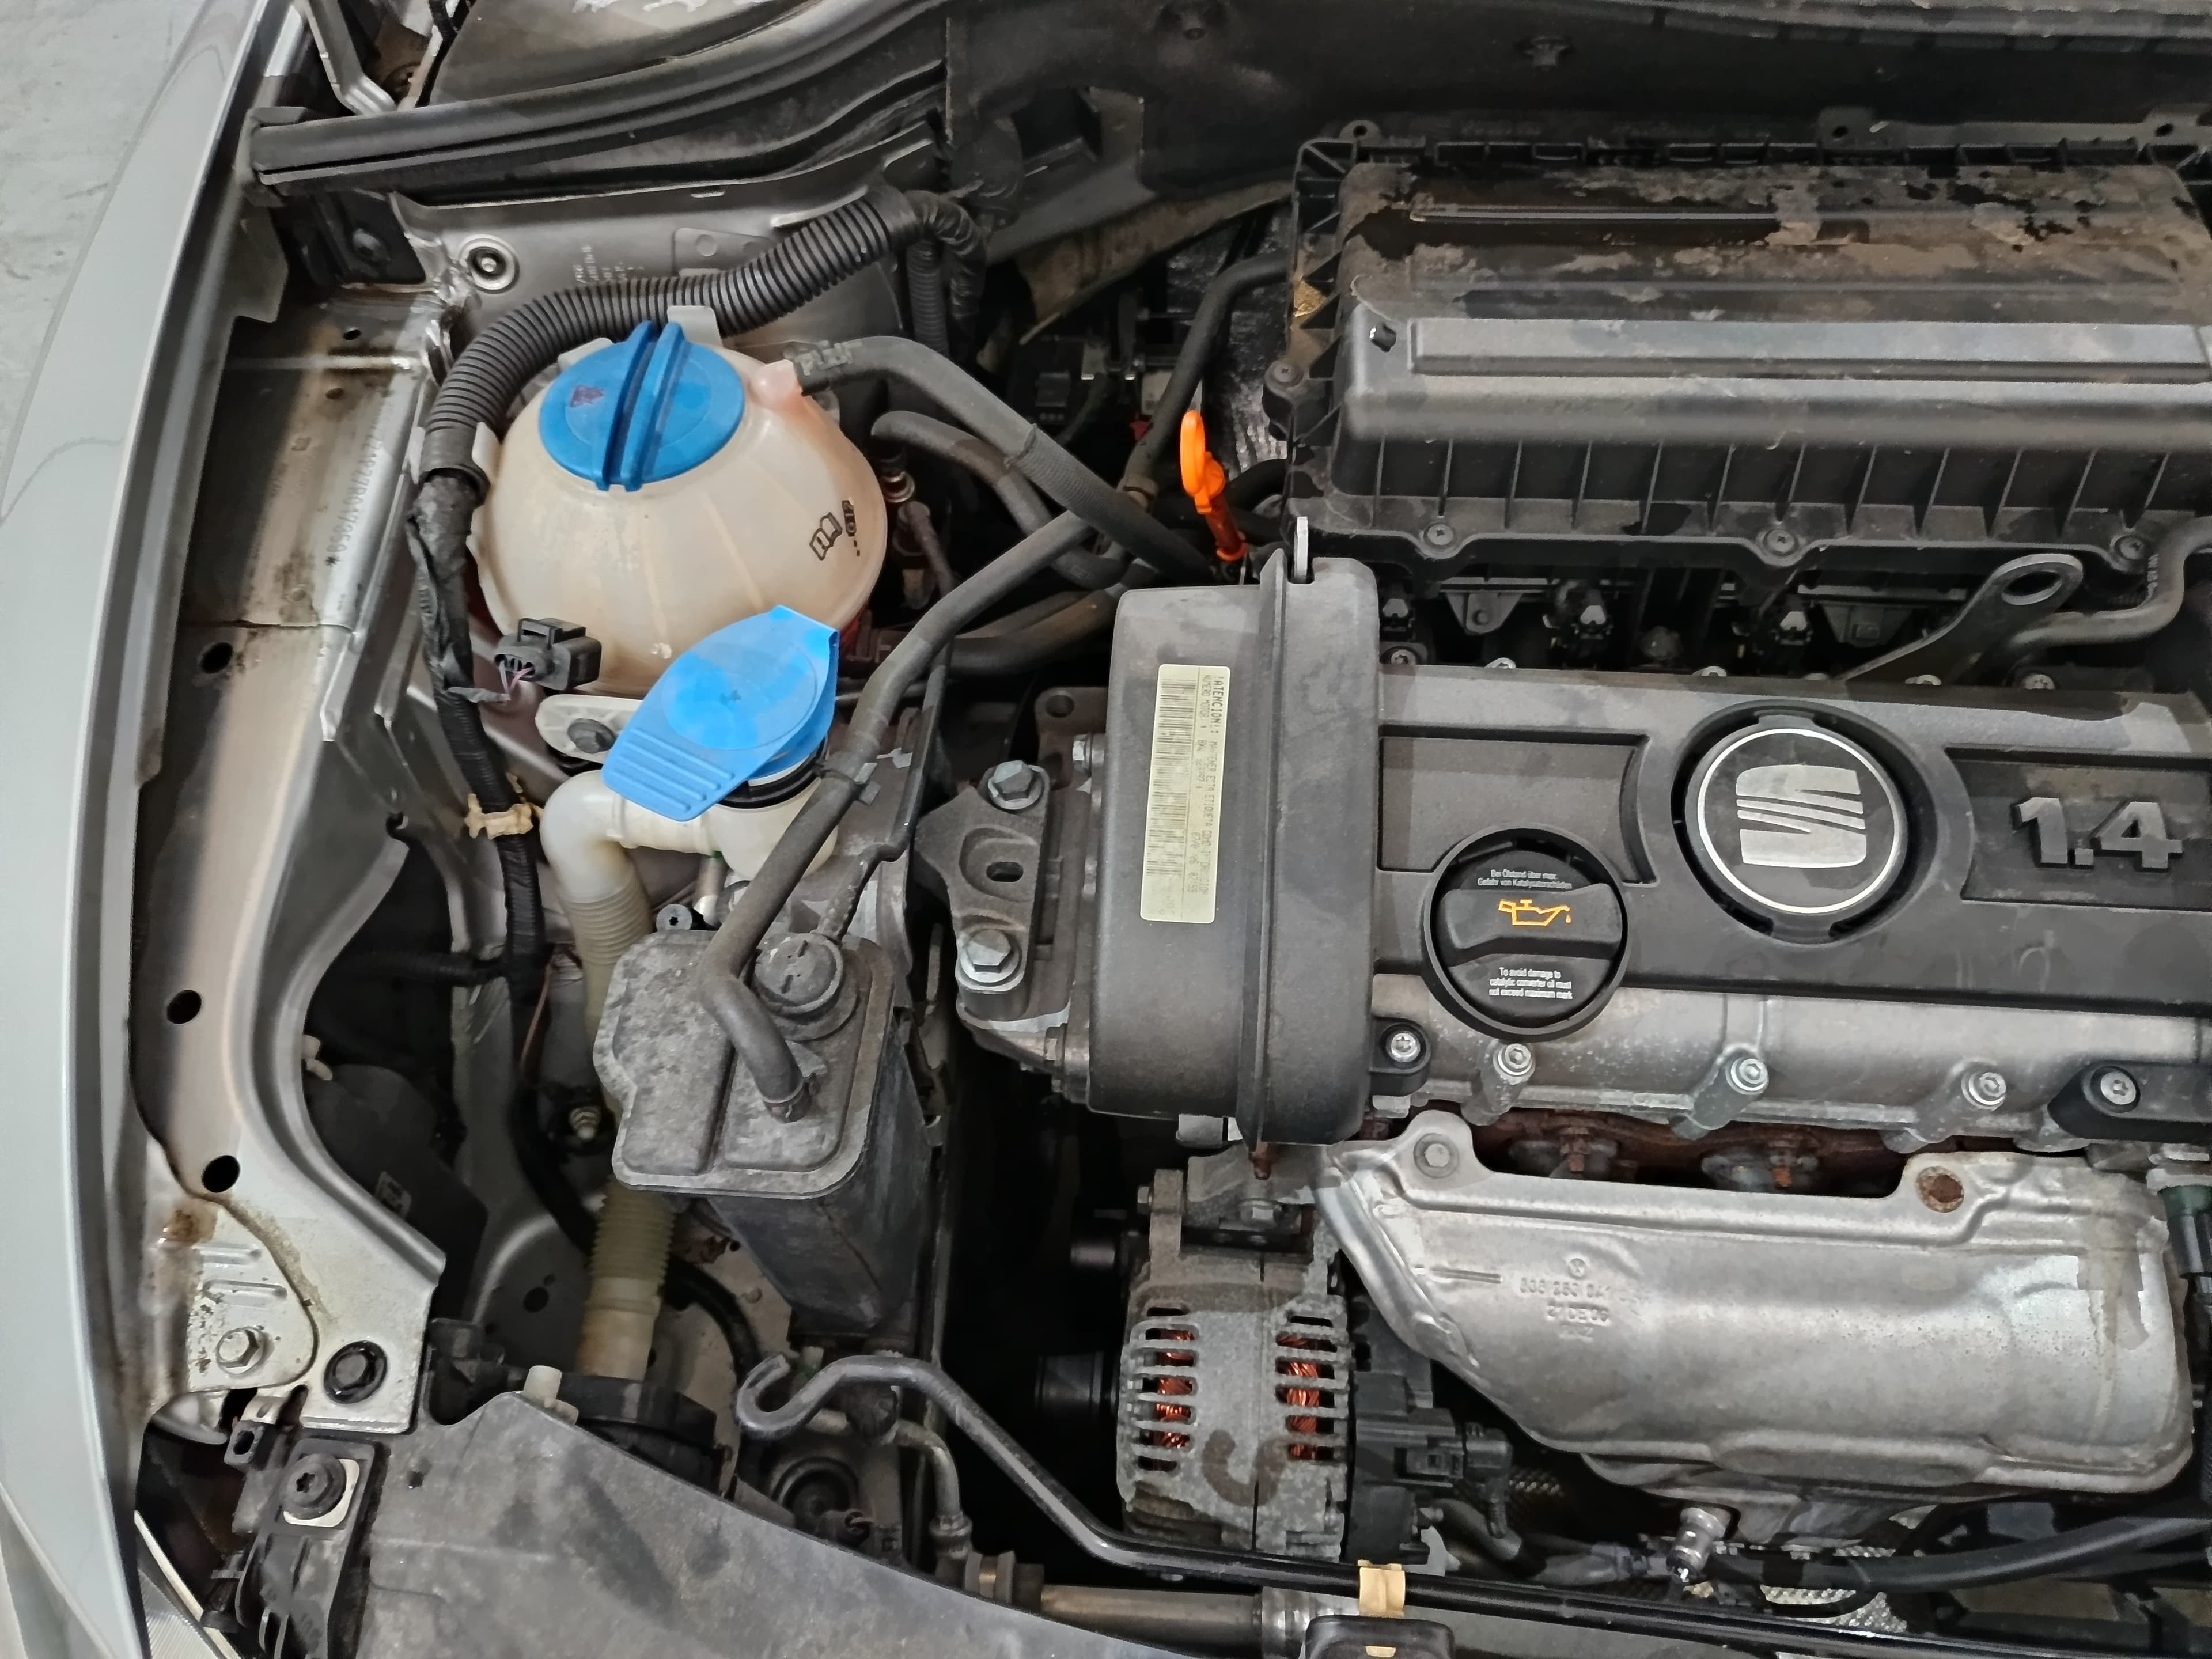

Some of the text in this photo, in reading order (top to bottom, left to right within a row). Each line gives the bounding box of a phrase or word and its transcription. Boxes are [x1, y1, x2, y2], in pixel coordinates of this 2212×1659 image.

[2012, 797, 2183, 871] 1.4
[1499, 967, 1562, 980] To avoid damage to
